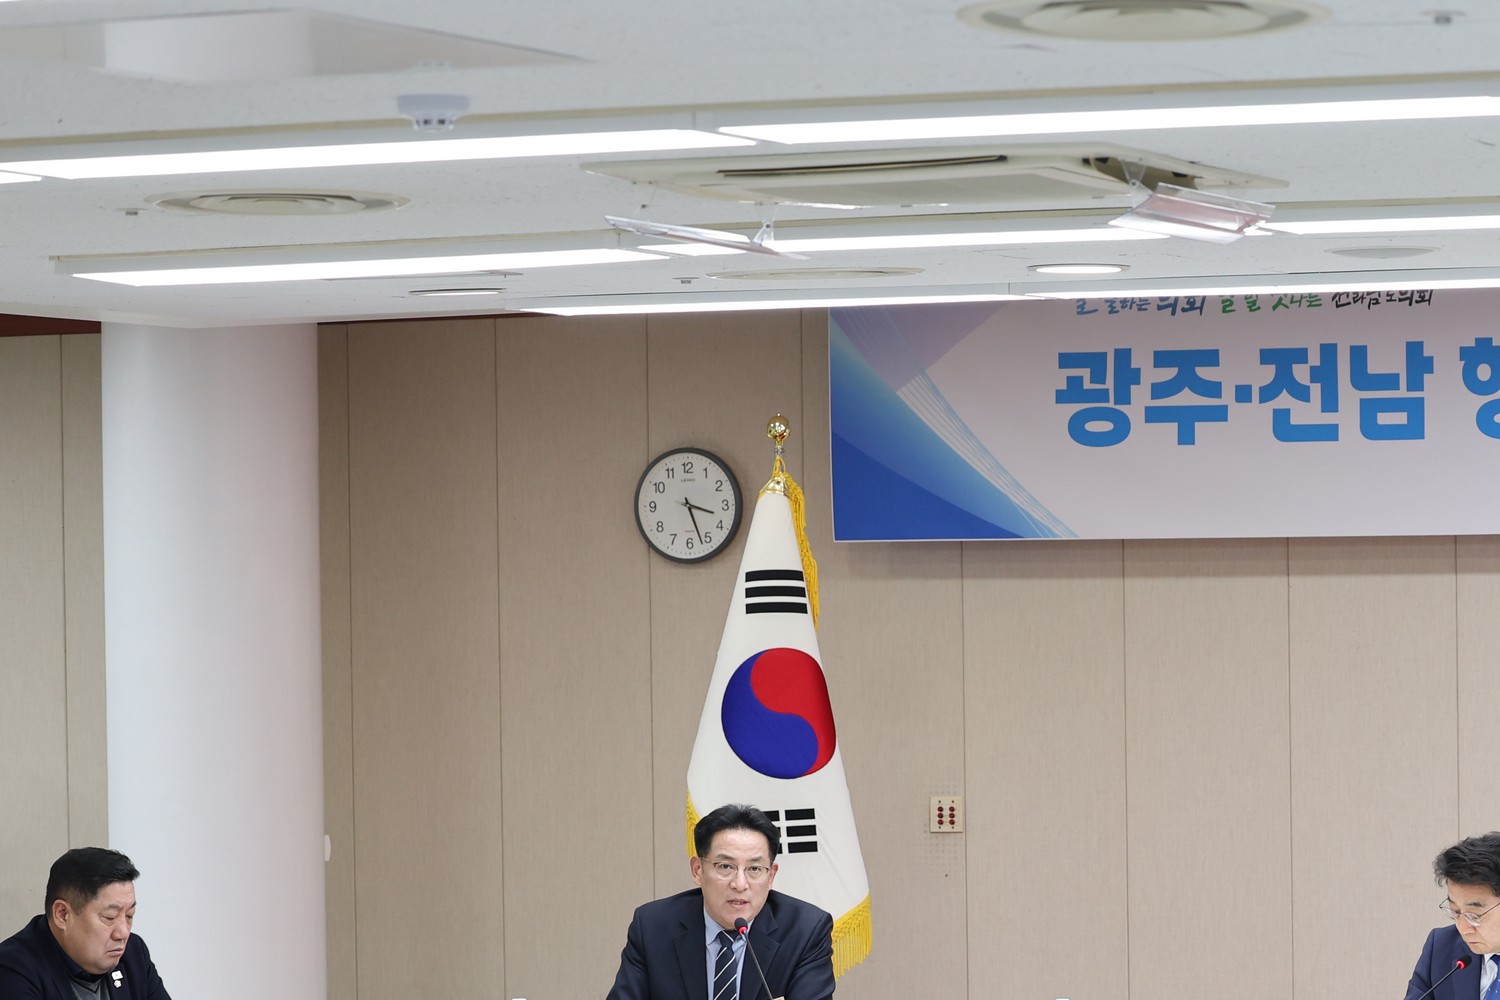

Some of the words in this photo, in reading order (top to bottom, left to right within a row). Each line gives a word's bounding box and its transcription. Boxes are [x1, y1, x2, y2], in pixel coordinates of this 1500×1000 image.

[1055, 341, 1435, 448] 광주·전남
[665, 468, 675, 479] 11
[682, 462, 693, 474] 12
[703, 467, 708, 479] 1
[653, 482, 666, 494] 10
[715, 480, 723, 492] 2
[649, 501, 657, 513] 9
[721, 499, 730, 511] 3
[656, 521, 664, 533] 8
[716, 520, 724, 531] 4
[669, 533, 677, 546] 7
[686, 537, 694, 550] 6
[704, 532, 712, 544] 5
